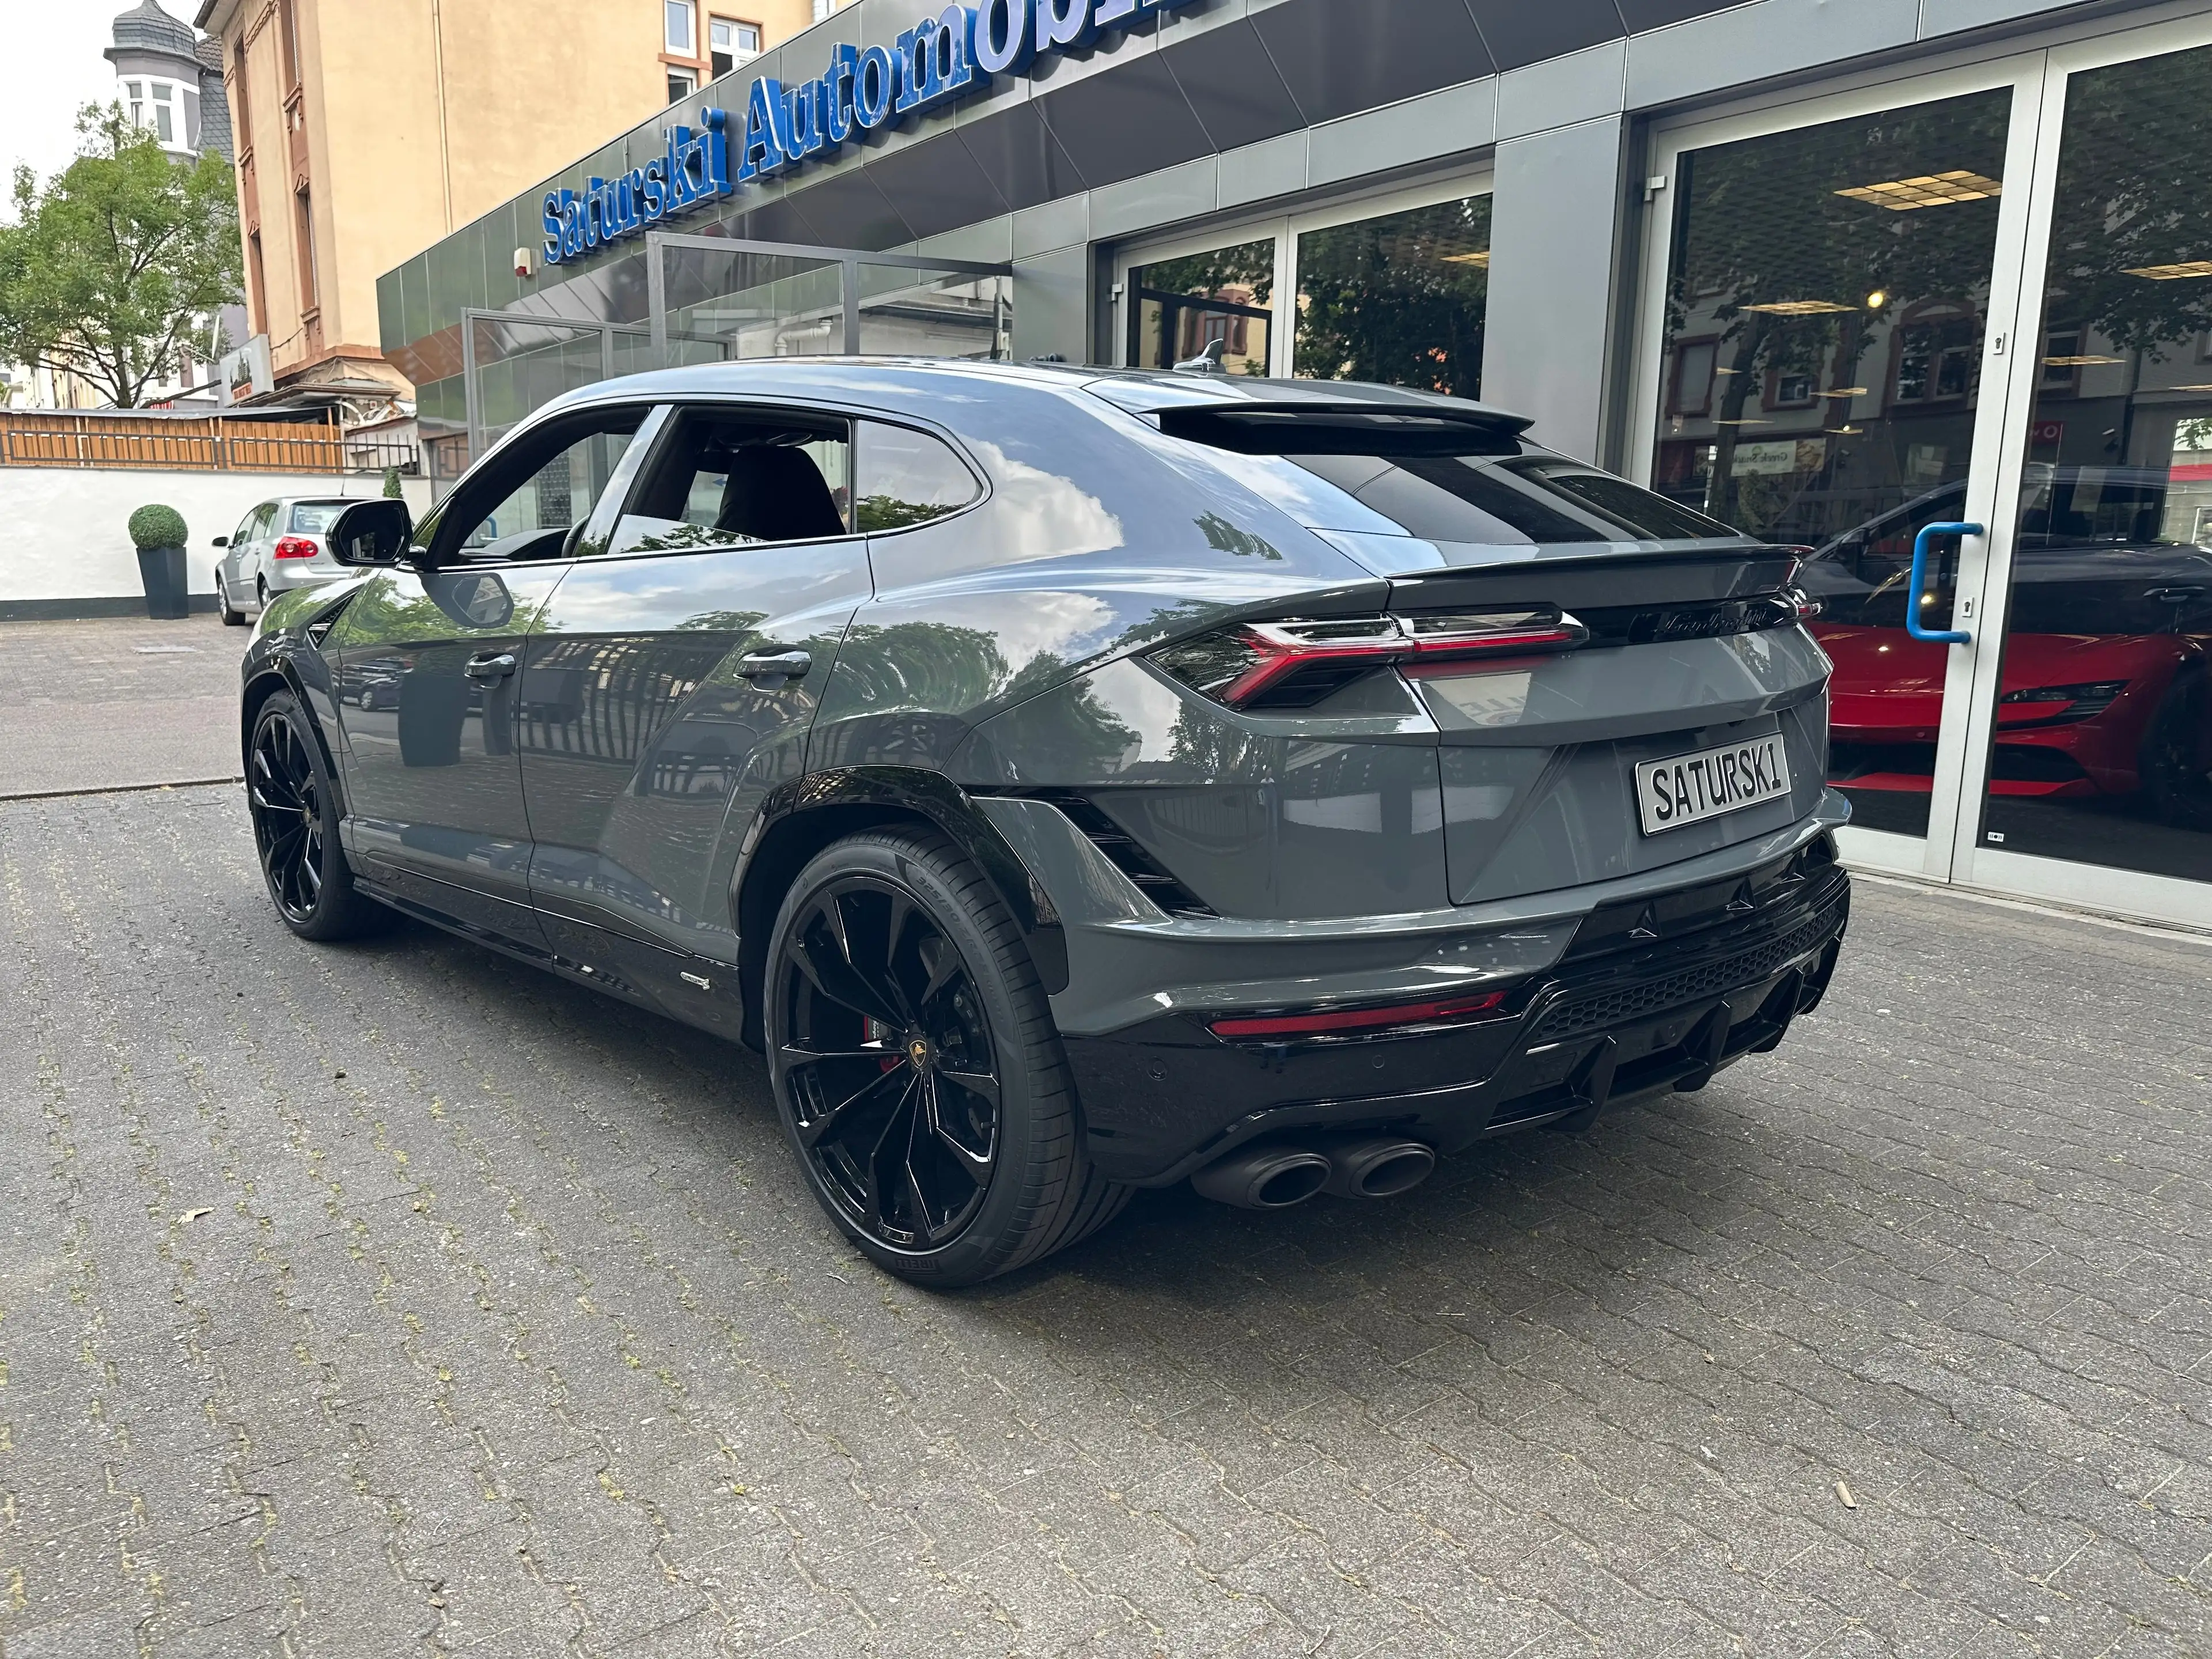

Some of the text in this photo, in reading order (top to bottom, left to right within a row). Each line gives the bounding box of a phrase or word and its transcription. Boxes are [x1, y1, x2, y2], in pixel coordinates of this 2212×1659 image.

[542, 0, 1160, 265] Saturski Automo
[1651, 742, 1781, 820] SATURSKI
